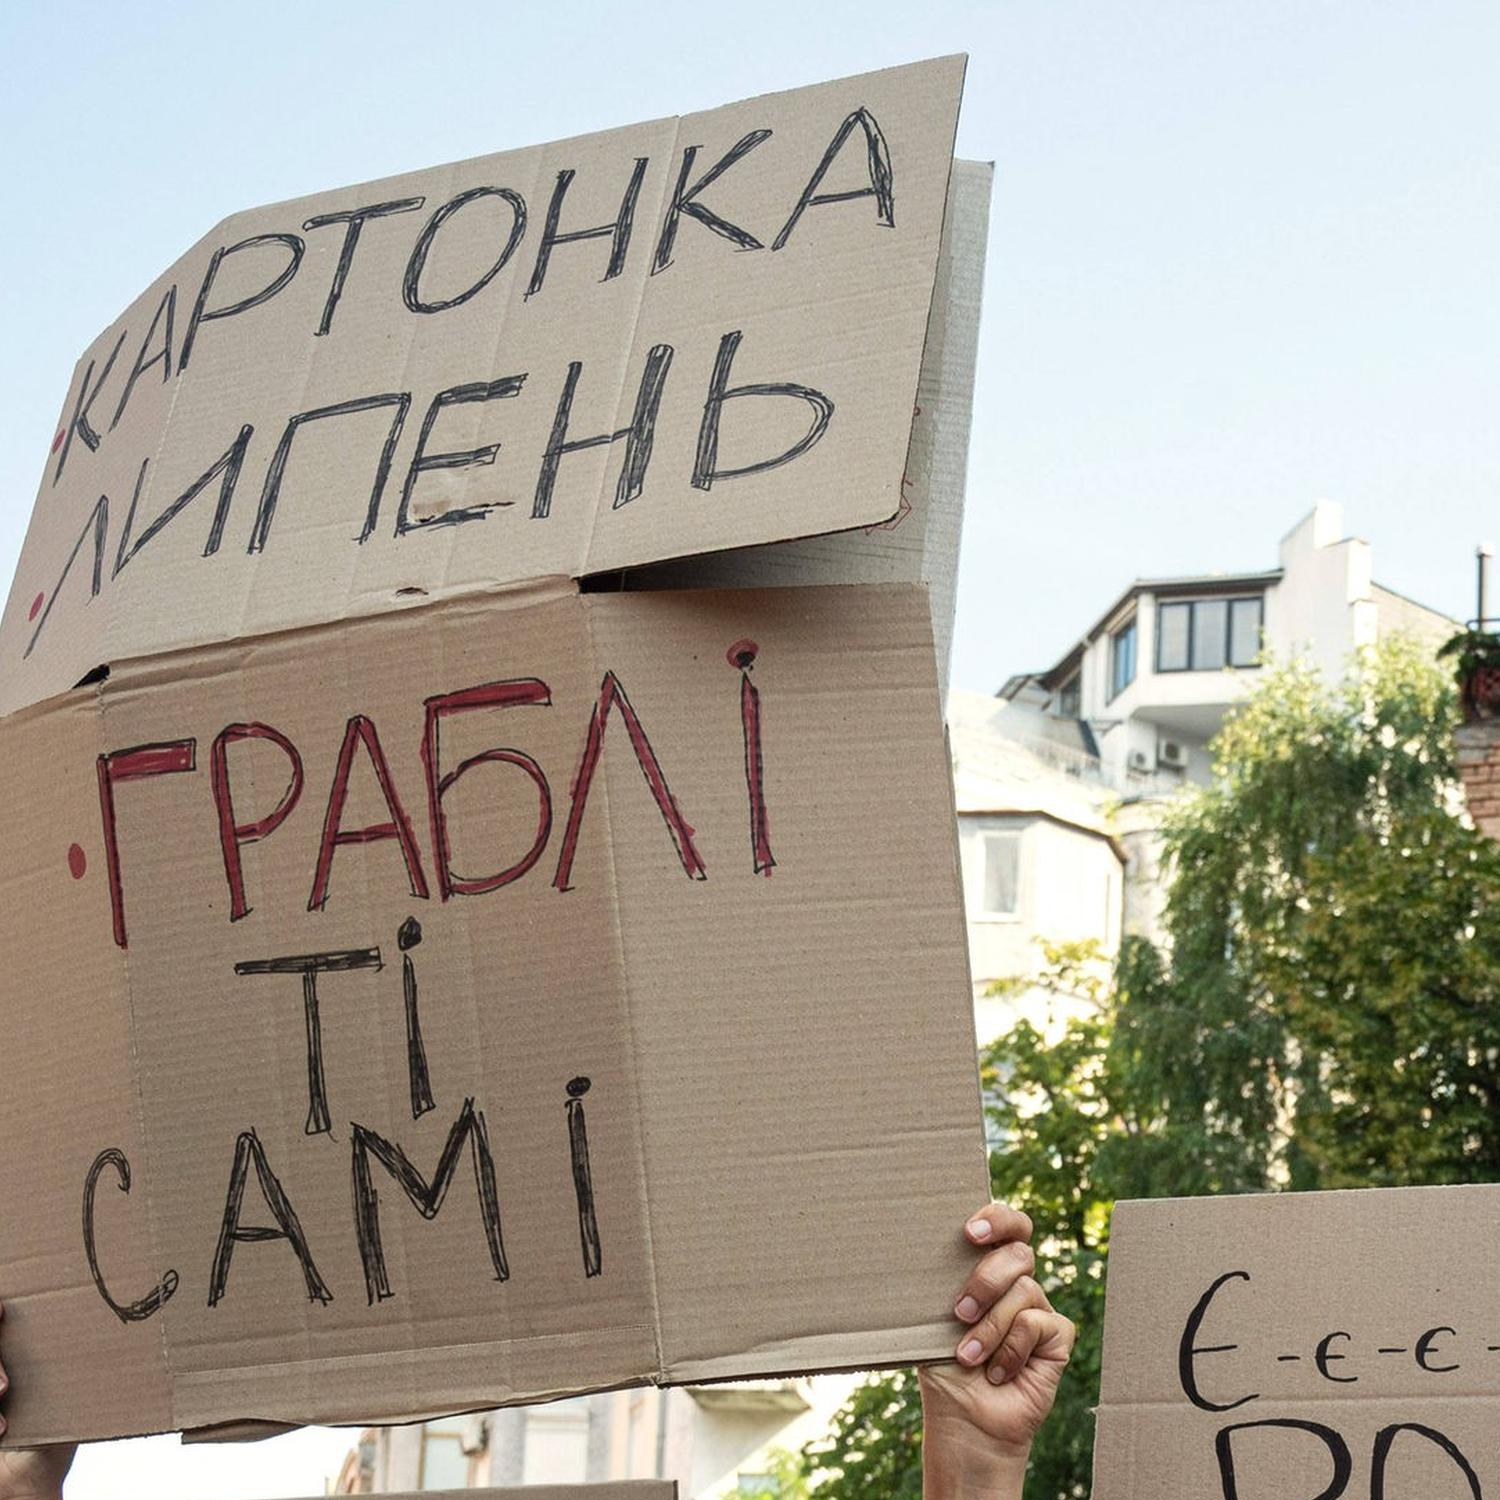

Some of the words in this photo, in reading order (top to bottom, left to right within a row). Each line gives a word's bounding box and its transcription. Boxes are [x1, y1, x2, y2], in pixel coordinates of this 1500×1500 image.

[54, 106, 896, 486] КАРТОНКА
[24, 330, 836, 660] ЛИПЕНЬ
[96, 638, 777, 949] ГРАБЛІ
[234, 916, 434, 1138] ТІ
[83, 1076, 602, 1324] САМІ
